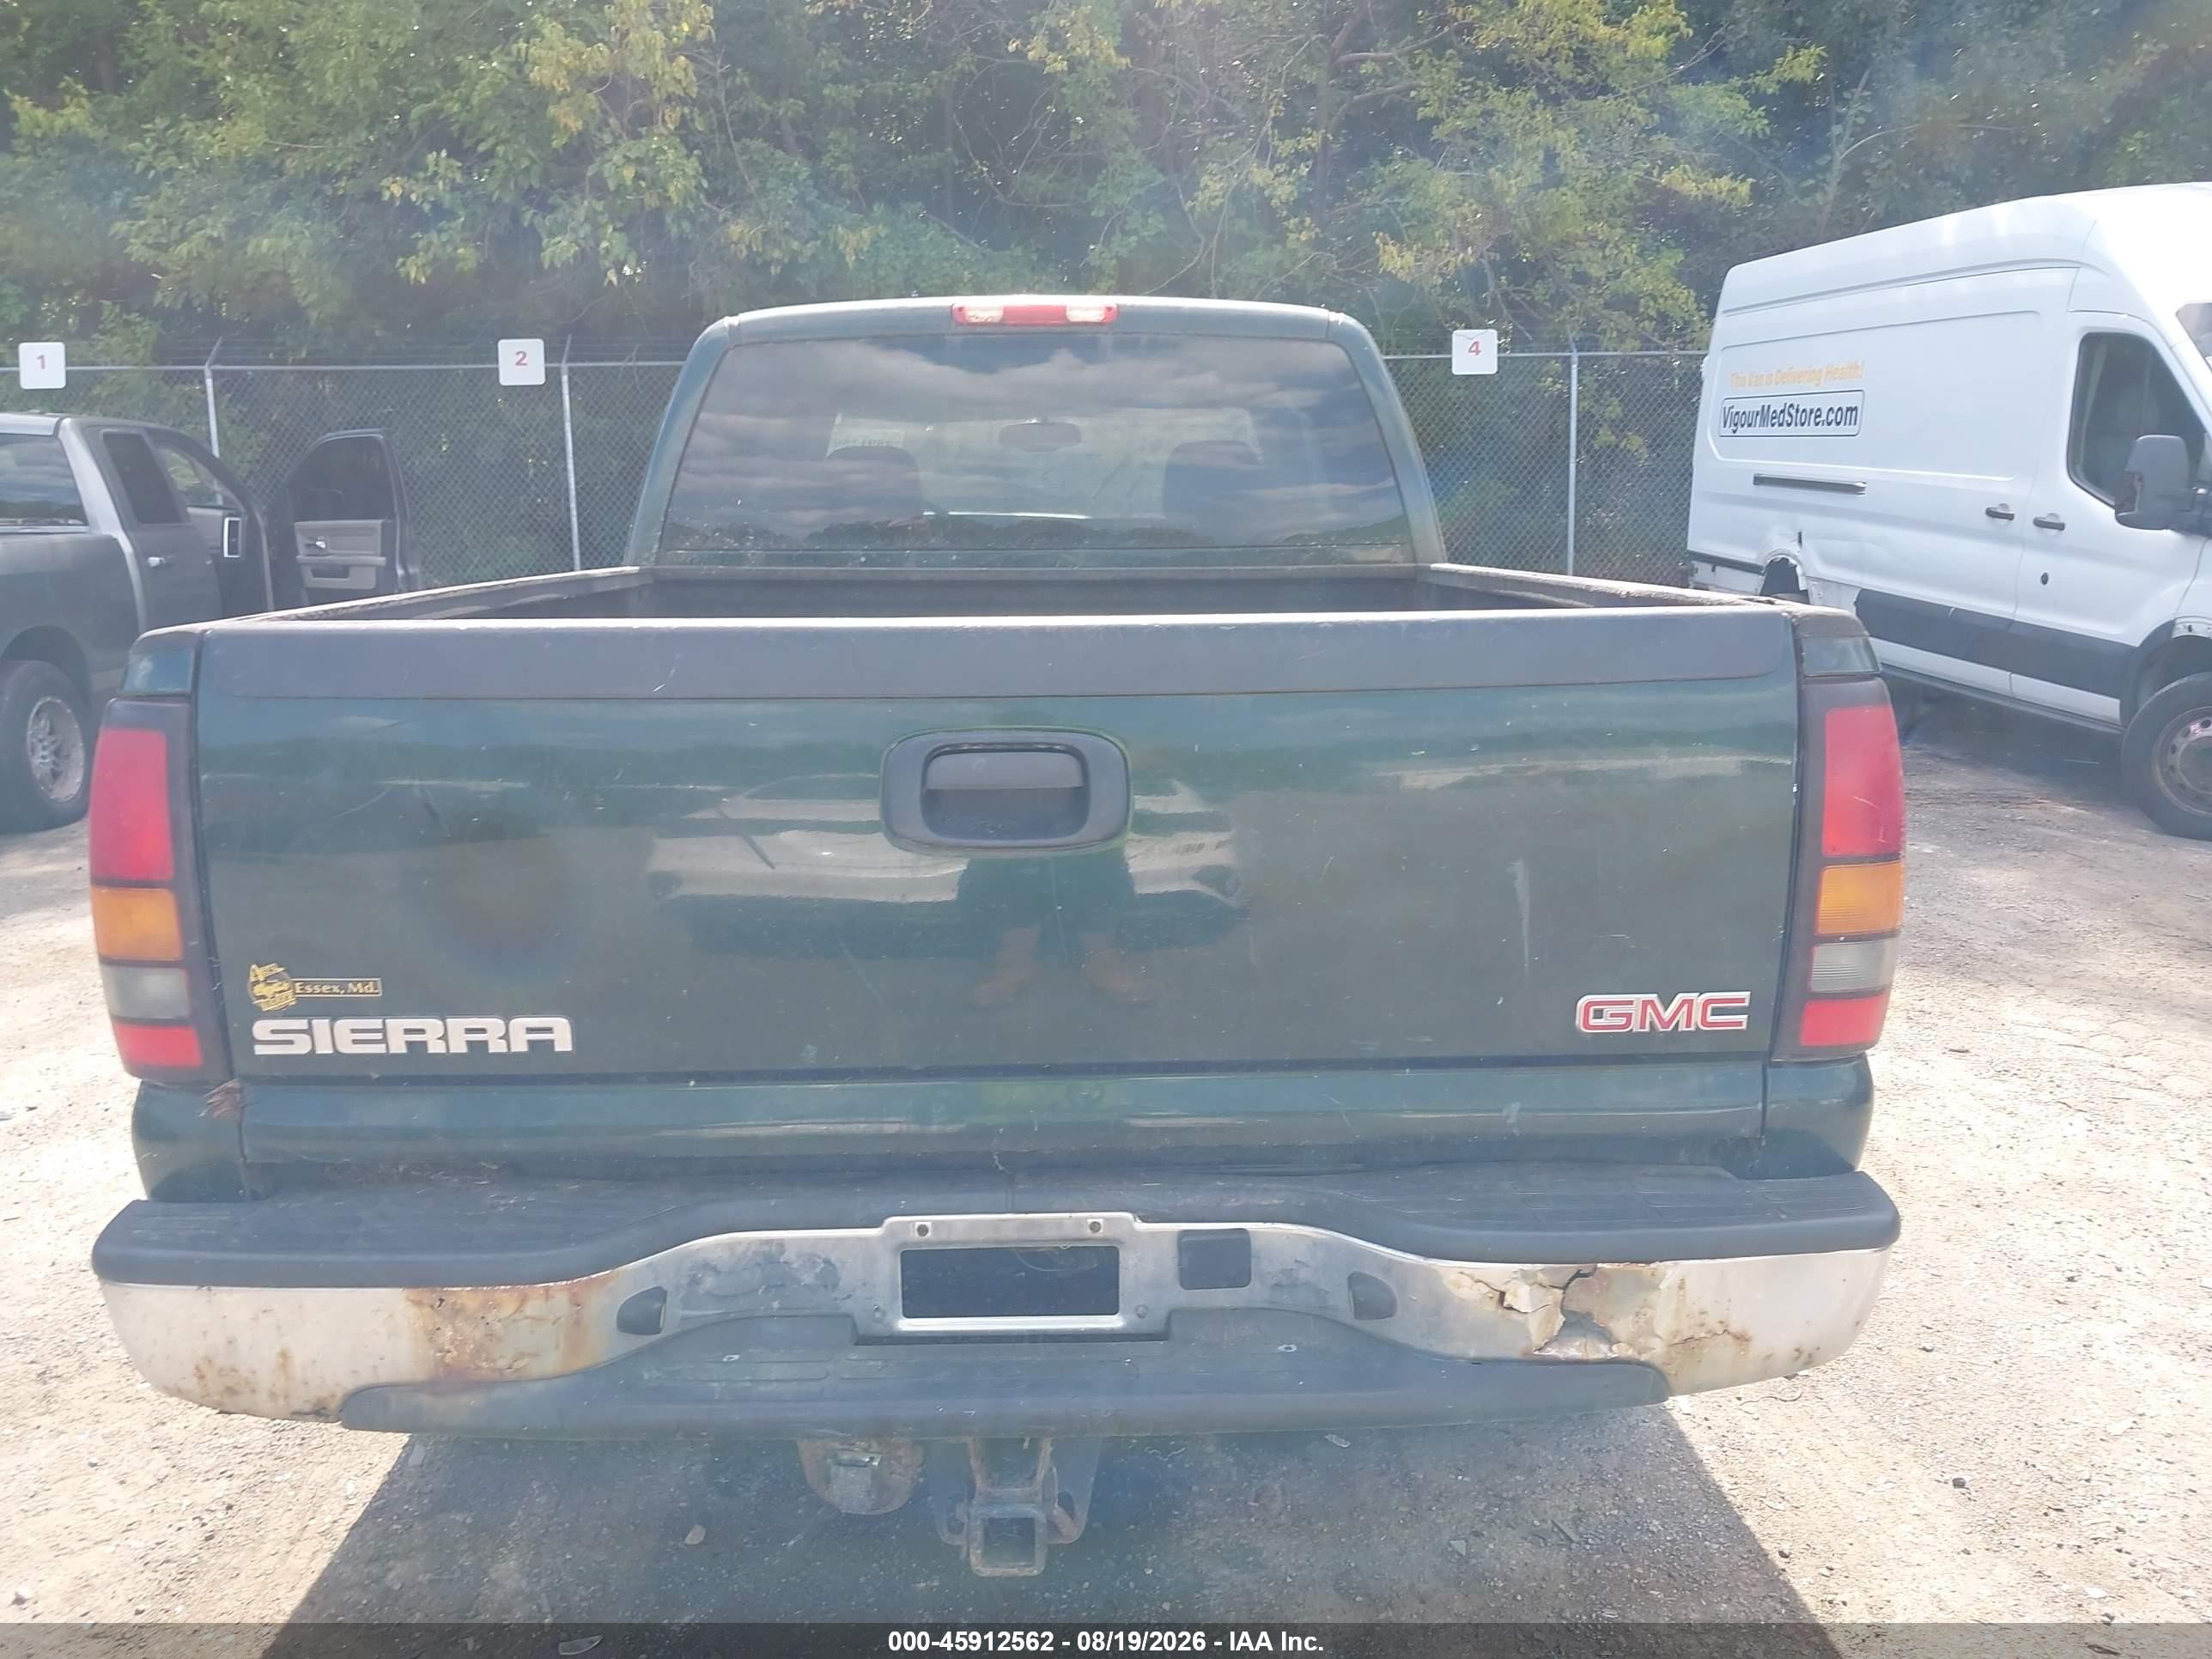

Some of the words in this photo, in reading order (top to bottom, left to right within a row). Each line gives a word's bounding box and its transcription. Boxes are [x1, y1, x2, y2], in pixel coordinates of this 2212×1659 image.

[1468, 341, 1481, 356] 4
[36, 354, 46, 370] 1
[514, 350, 528, 367] 2
[1723, 403, 1858, 434] VigourMedStore.com
[295, 981, 343, 995] Essex,
[347, 981, 379, 994] Md.
[1576, 991, 1751, 1033] GMC
[252, 1016, 573, 1055] SIERRA
